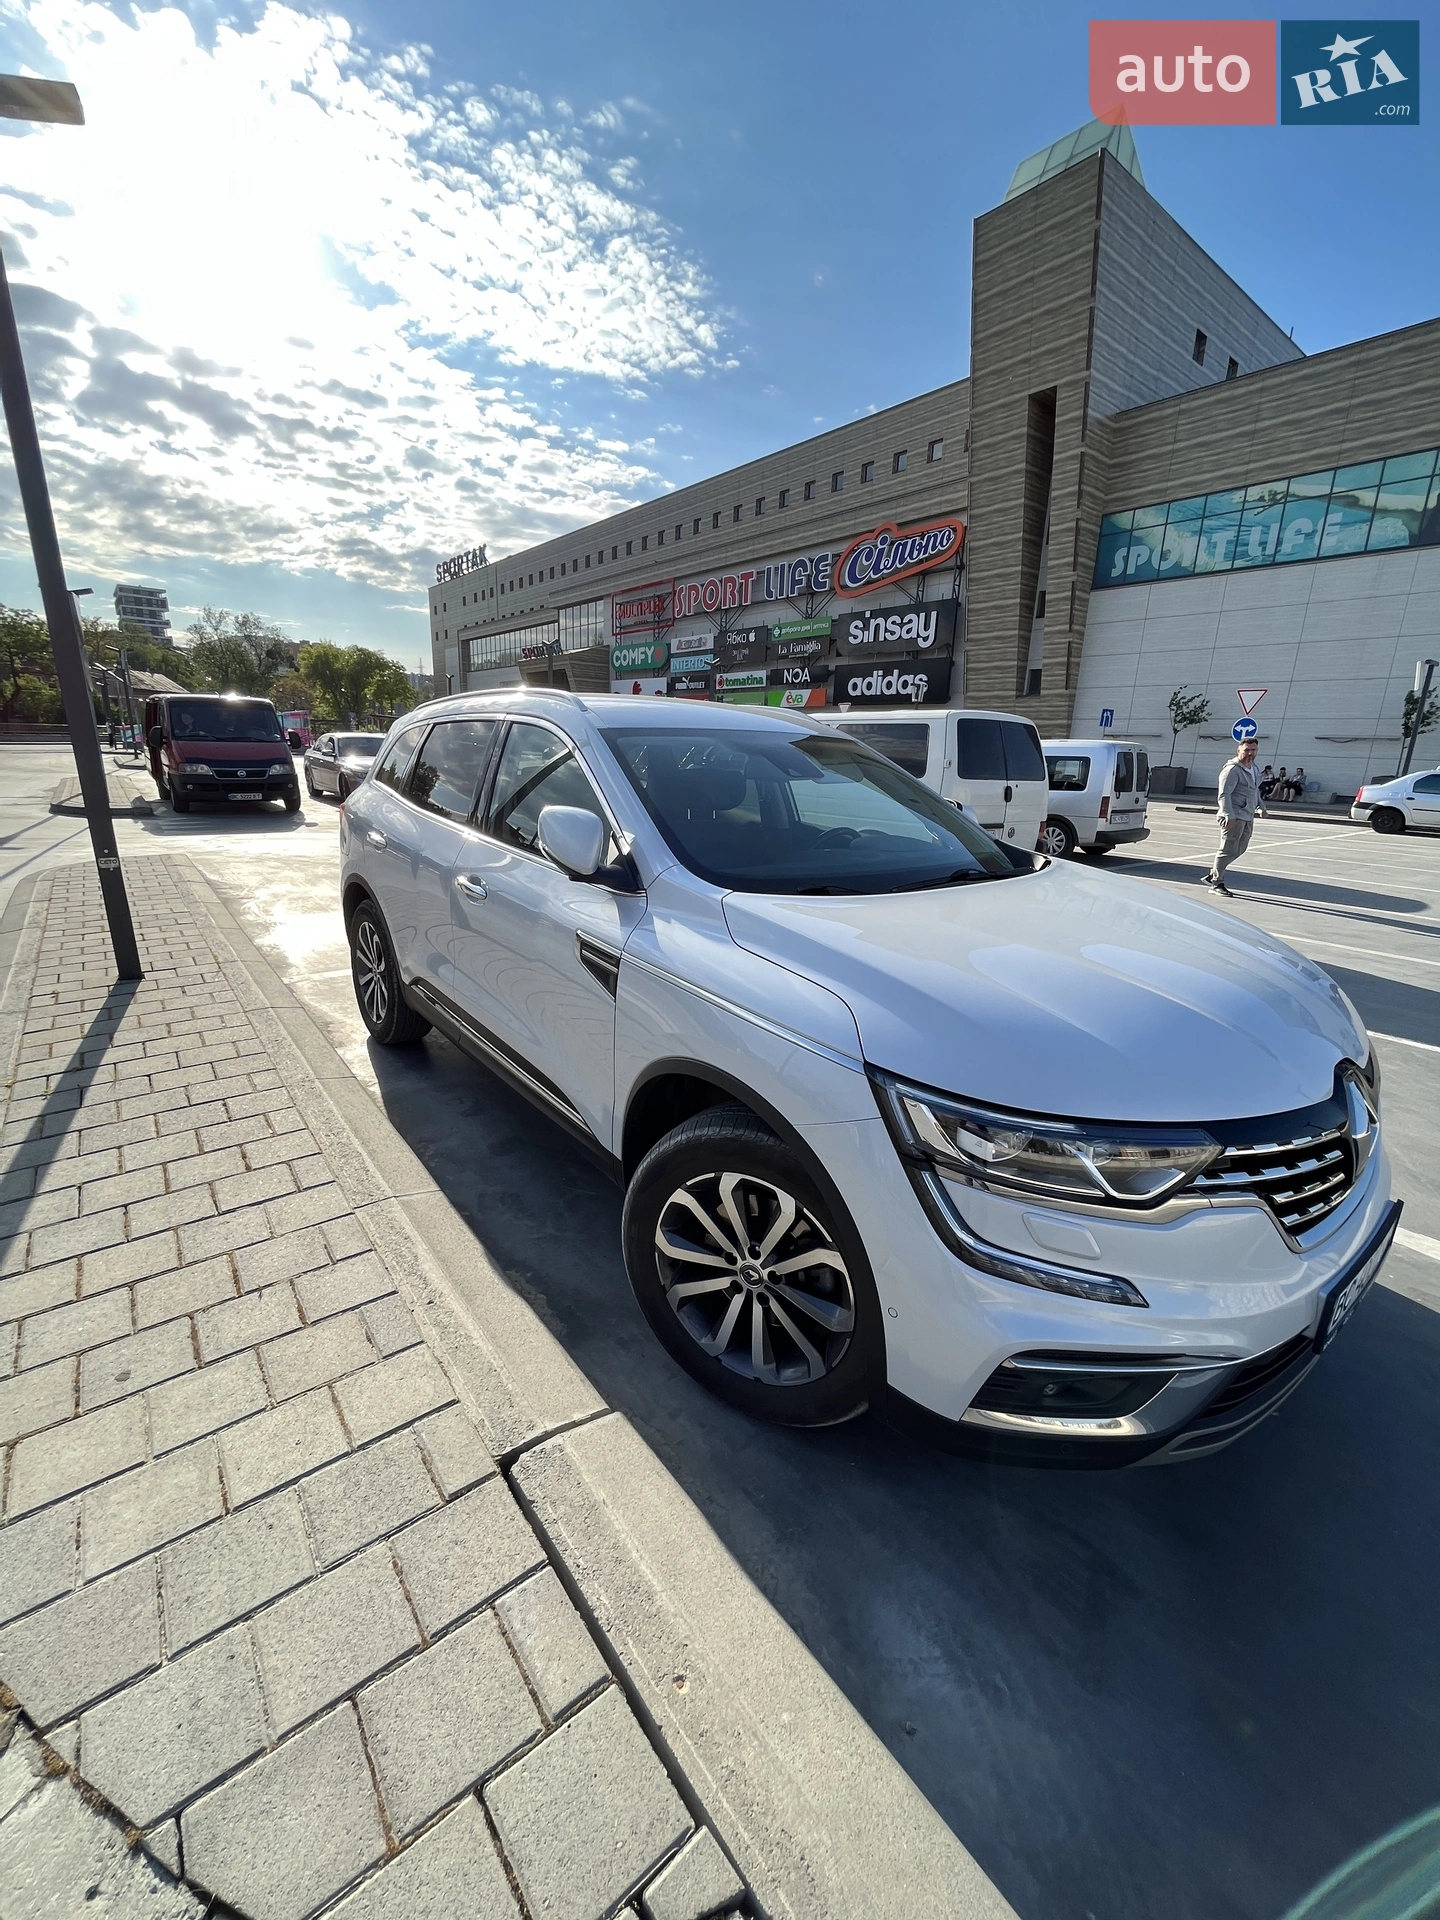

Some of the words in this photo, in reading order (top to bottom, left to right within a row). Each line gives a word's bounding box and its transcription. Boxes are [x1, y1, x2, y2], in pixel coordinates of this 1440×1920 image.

[845, 527, 954, 588] Сільпо
[1110, 530, 1239, 577] SPORT
[1247, 512, 1343, 557] LIFE
[675, 569, 756, 618] SPORT
[764, 552, 831, 600] LIFE
[726, 631, 747, 645] Ябко
[849, 610, 937, 648] sinsay
[613, 646, 654, 667] COMFY
[725, 674, 764, 687] tomatina
[848, 669, 928, 696] adidas
